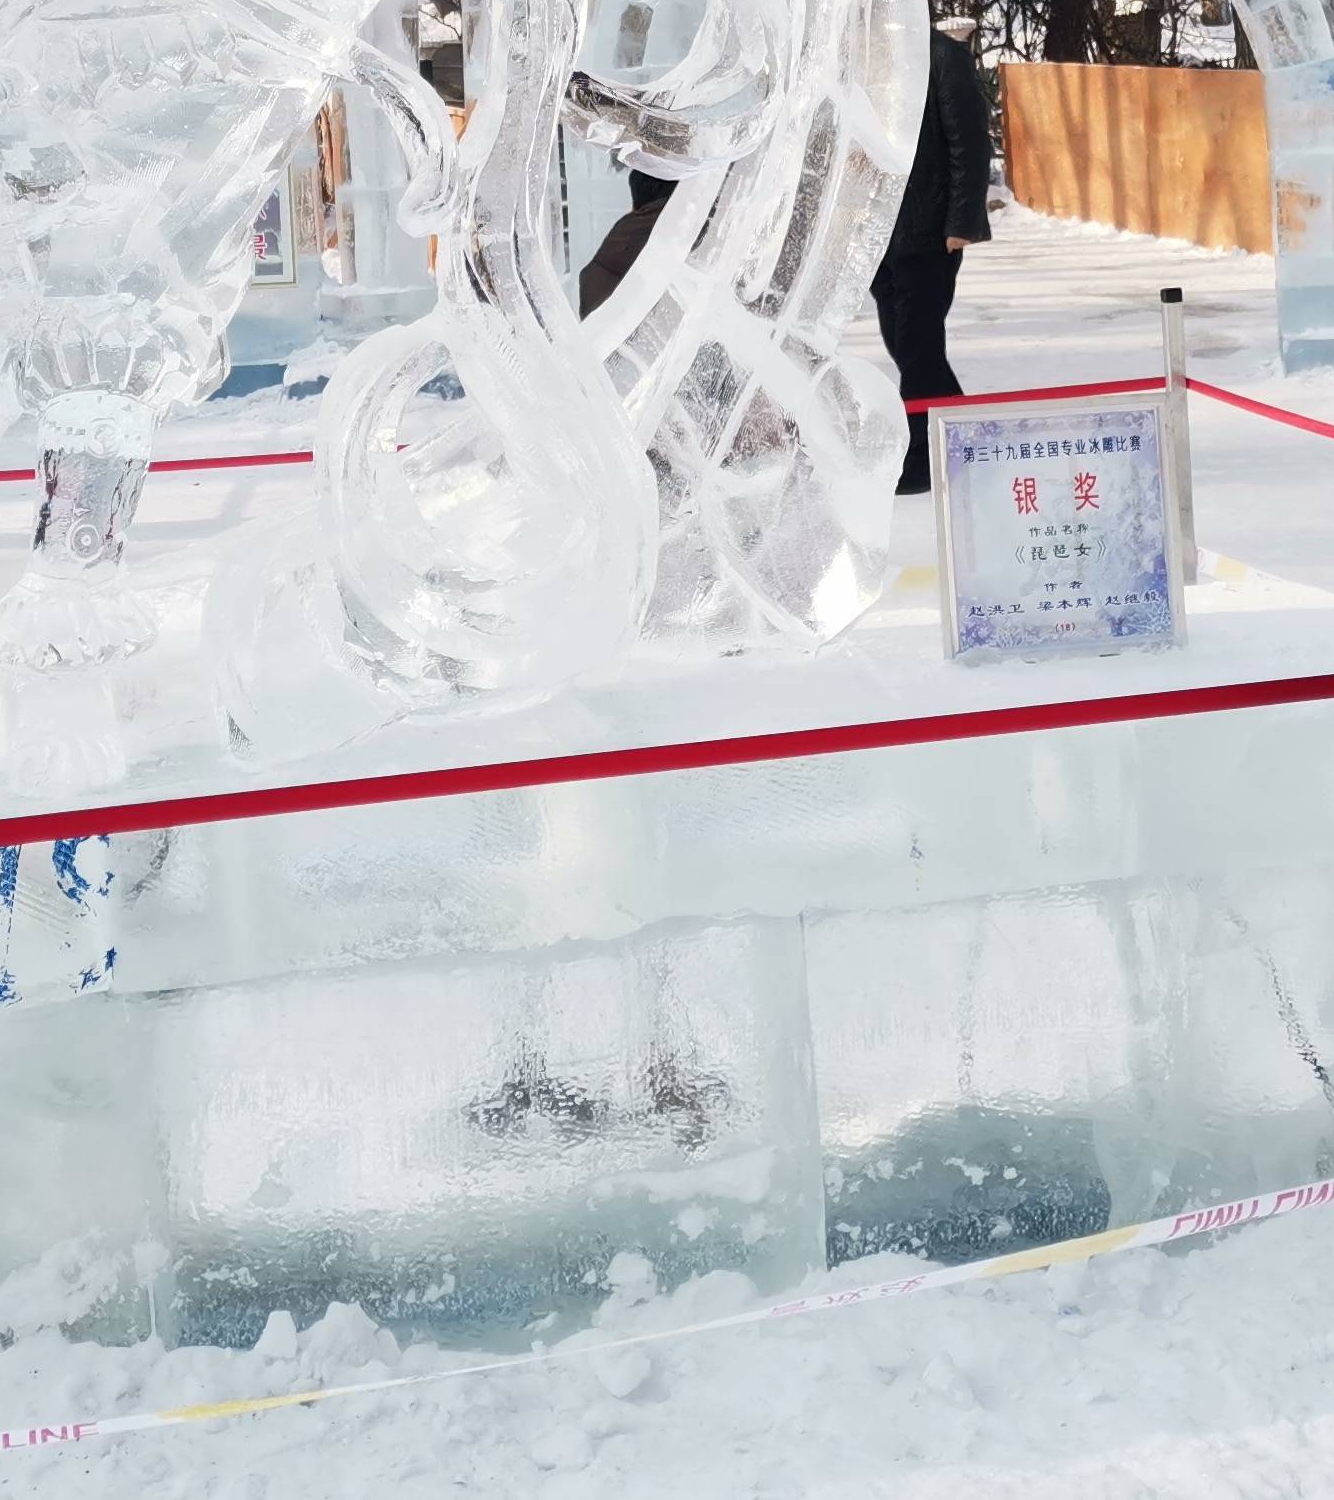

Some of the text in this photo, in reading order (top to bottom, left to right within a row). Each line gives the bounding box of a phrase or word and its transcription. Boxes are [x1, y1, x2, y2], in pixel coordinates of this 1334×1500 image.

[963, 435, 1142, 464] 第三十九届全国专业冰雕比赛
[1028, 523, 1089, 538] 作品名称
[1055, 622, 1076, 634] (18)
